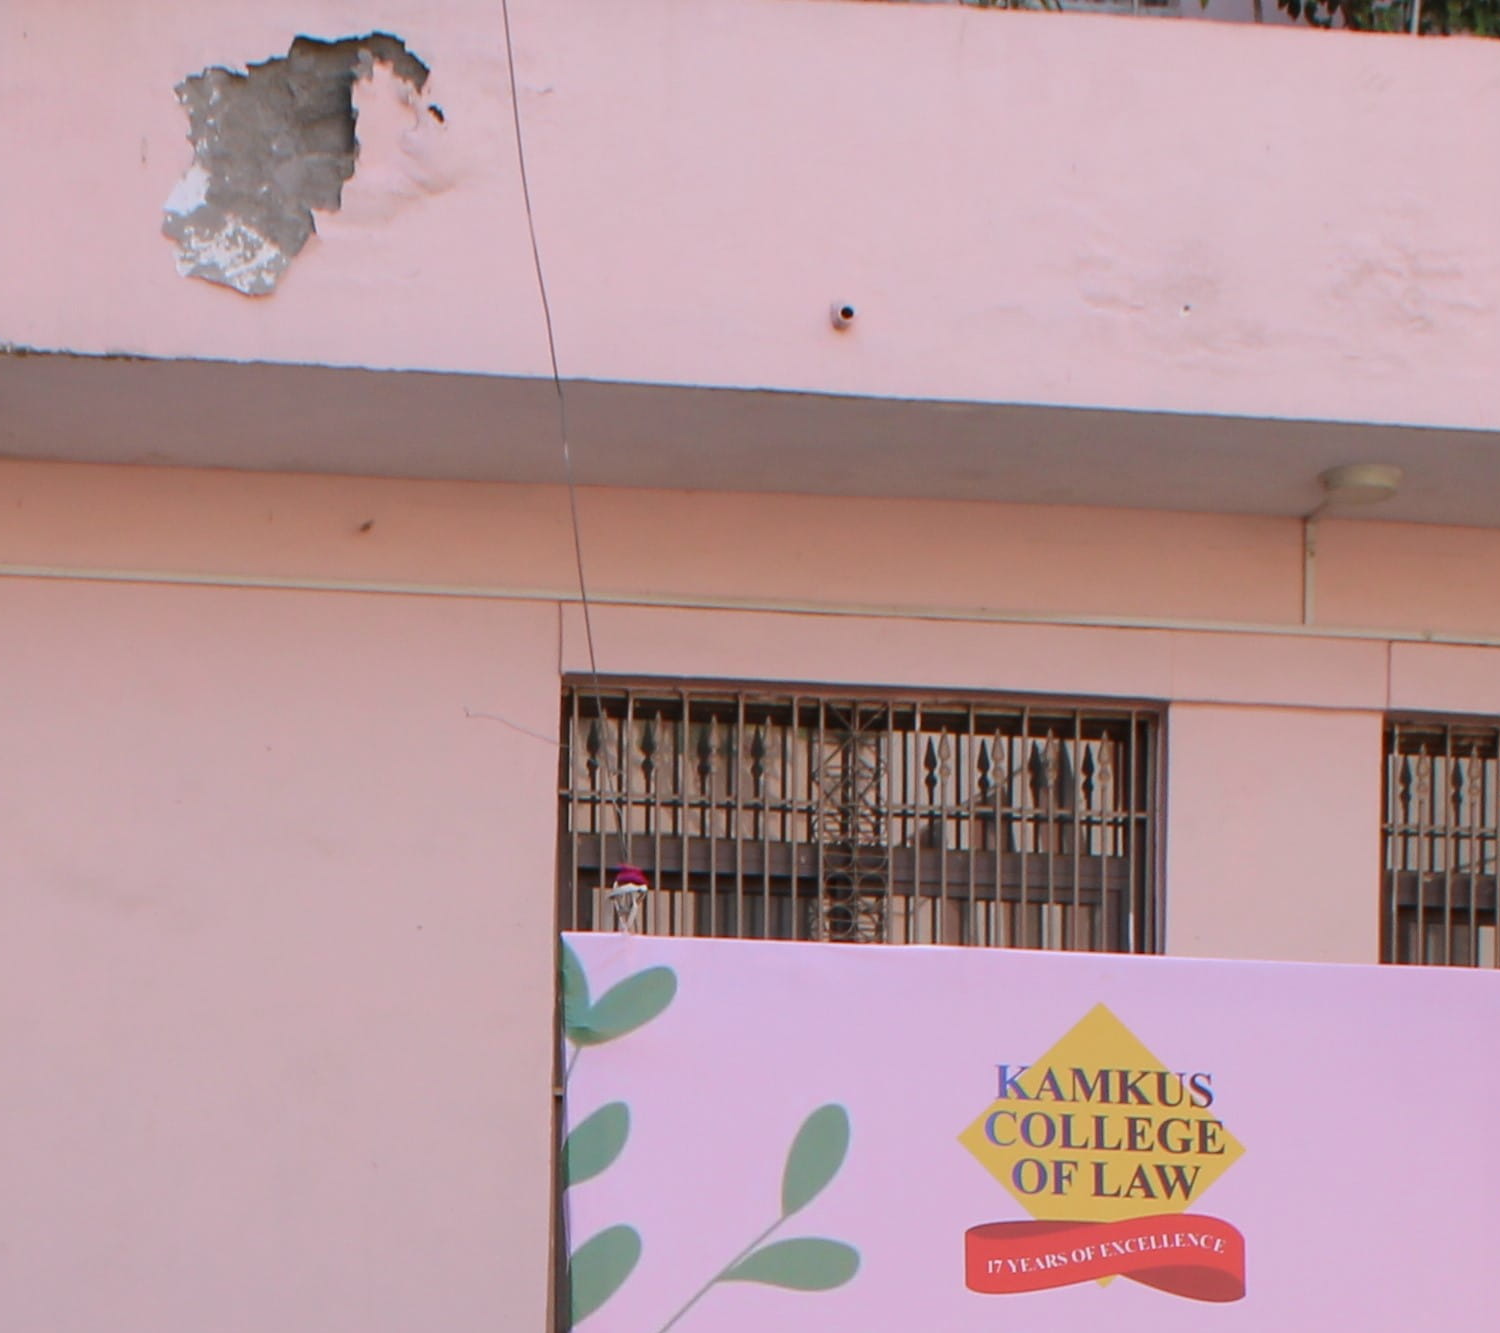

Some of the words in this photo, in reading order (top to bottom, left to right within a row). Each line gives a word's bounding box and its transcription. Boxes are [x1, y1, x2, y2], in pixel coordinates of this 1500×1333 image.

[995, 1064, 1214, 1109] KAMKUS
[984, 1110, 1226, 1155] COLLEGE
[1011, 1158, 1079, 1195] OF
[1090, 1161, 1202, 1201] LAW
[987, 1260, 1003, 1273] 17
[1006, 1251, 1068, 1274] YEARS
[1072, 1245, 1095, 1264] OF
[1100, 1232, 1227, 1258] EXCELLENCE
